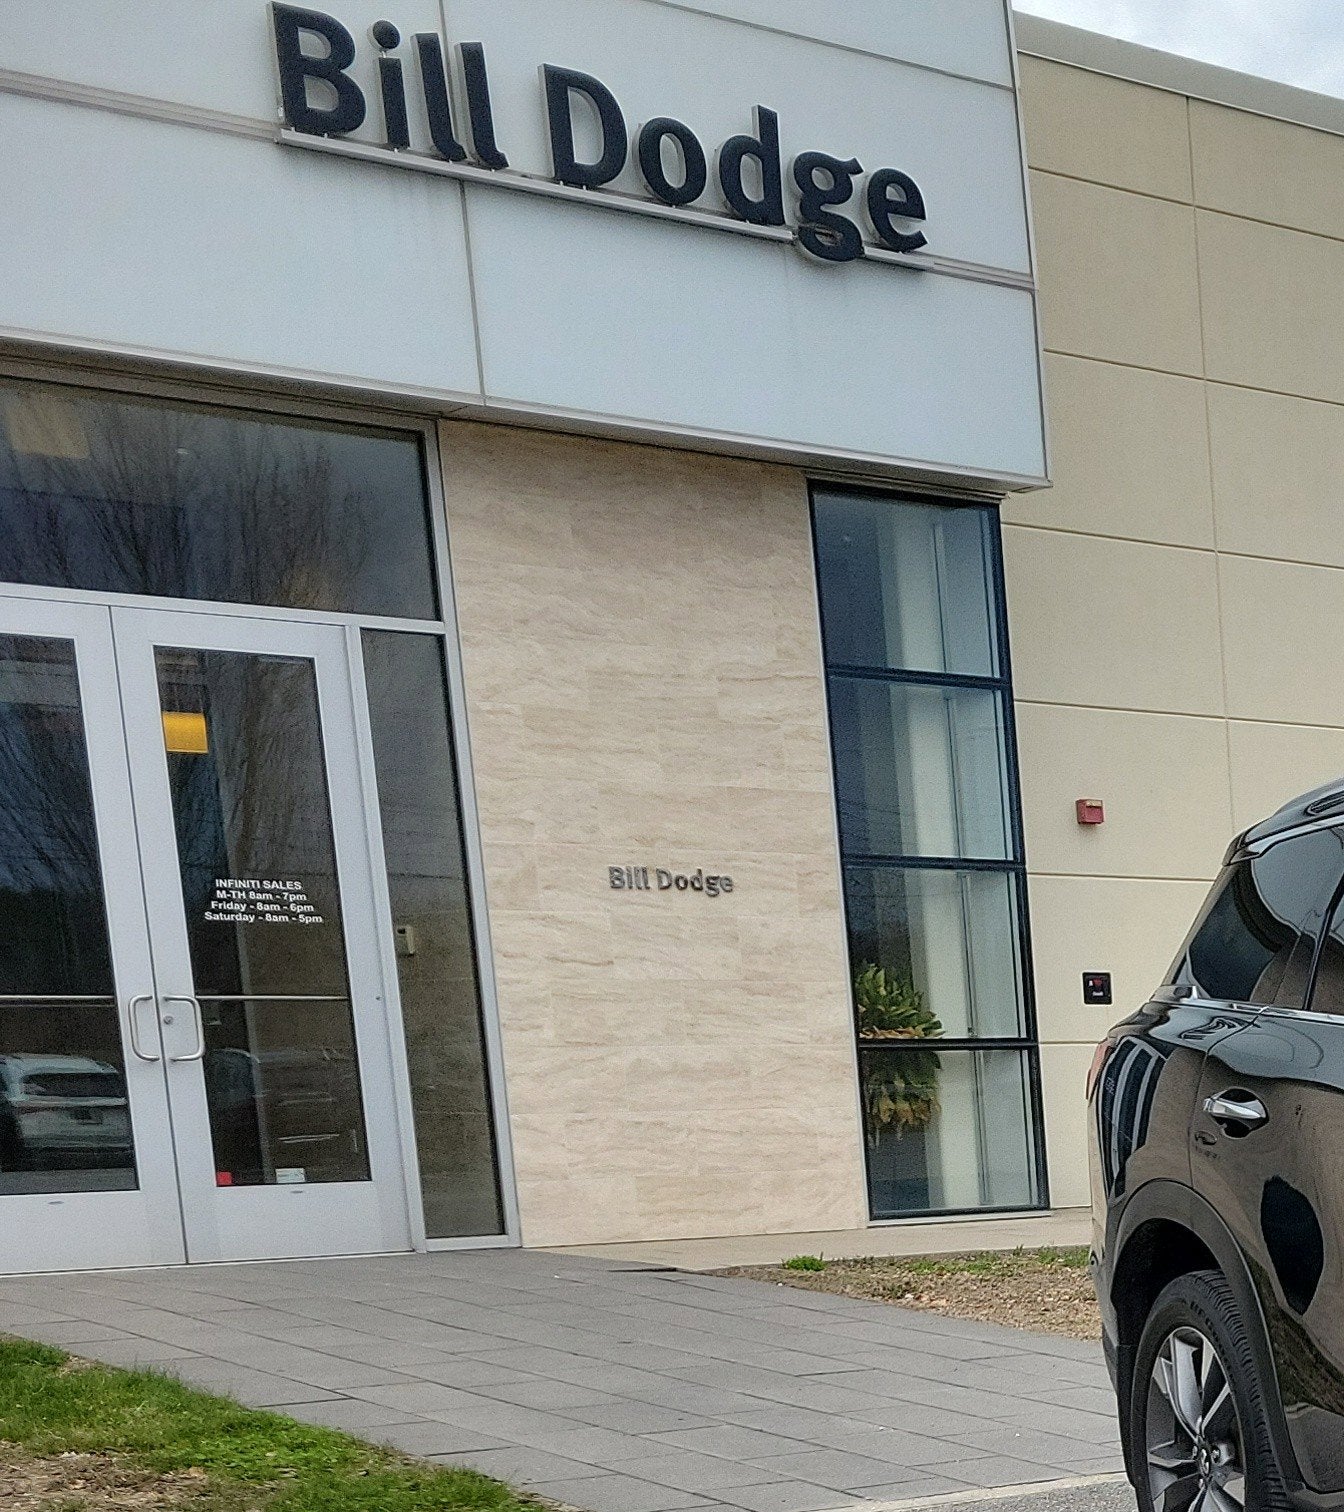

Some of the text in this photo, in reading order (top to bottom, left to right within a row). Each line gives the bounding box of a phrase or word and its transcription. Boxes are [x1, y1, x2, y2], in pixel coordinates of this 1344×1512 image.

[271, 2, 927, 262] Bill Dodge
[215, 879, 302, 890] INFINITI SALES
[608, 866, 733, 897] Bill Dodge
[216, 890, 246, 899] M-TH
[249, 891, 273, 900] 8am
[283, 892, 307, 902] 7pm
[211, 901, 247, 912] Friday
[204, 911, 256, 923] Saturday
[265, 913, 289, 922] 8am
